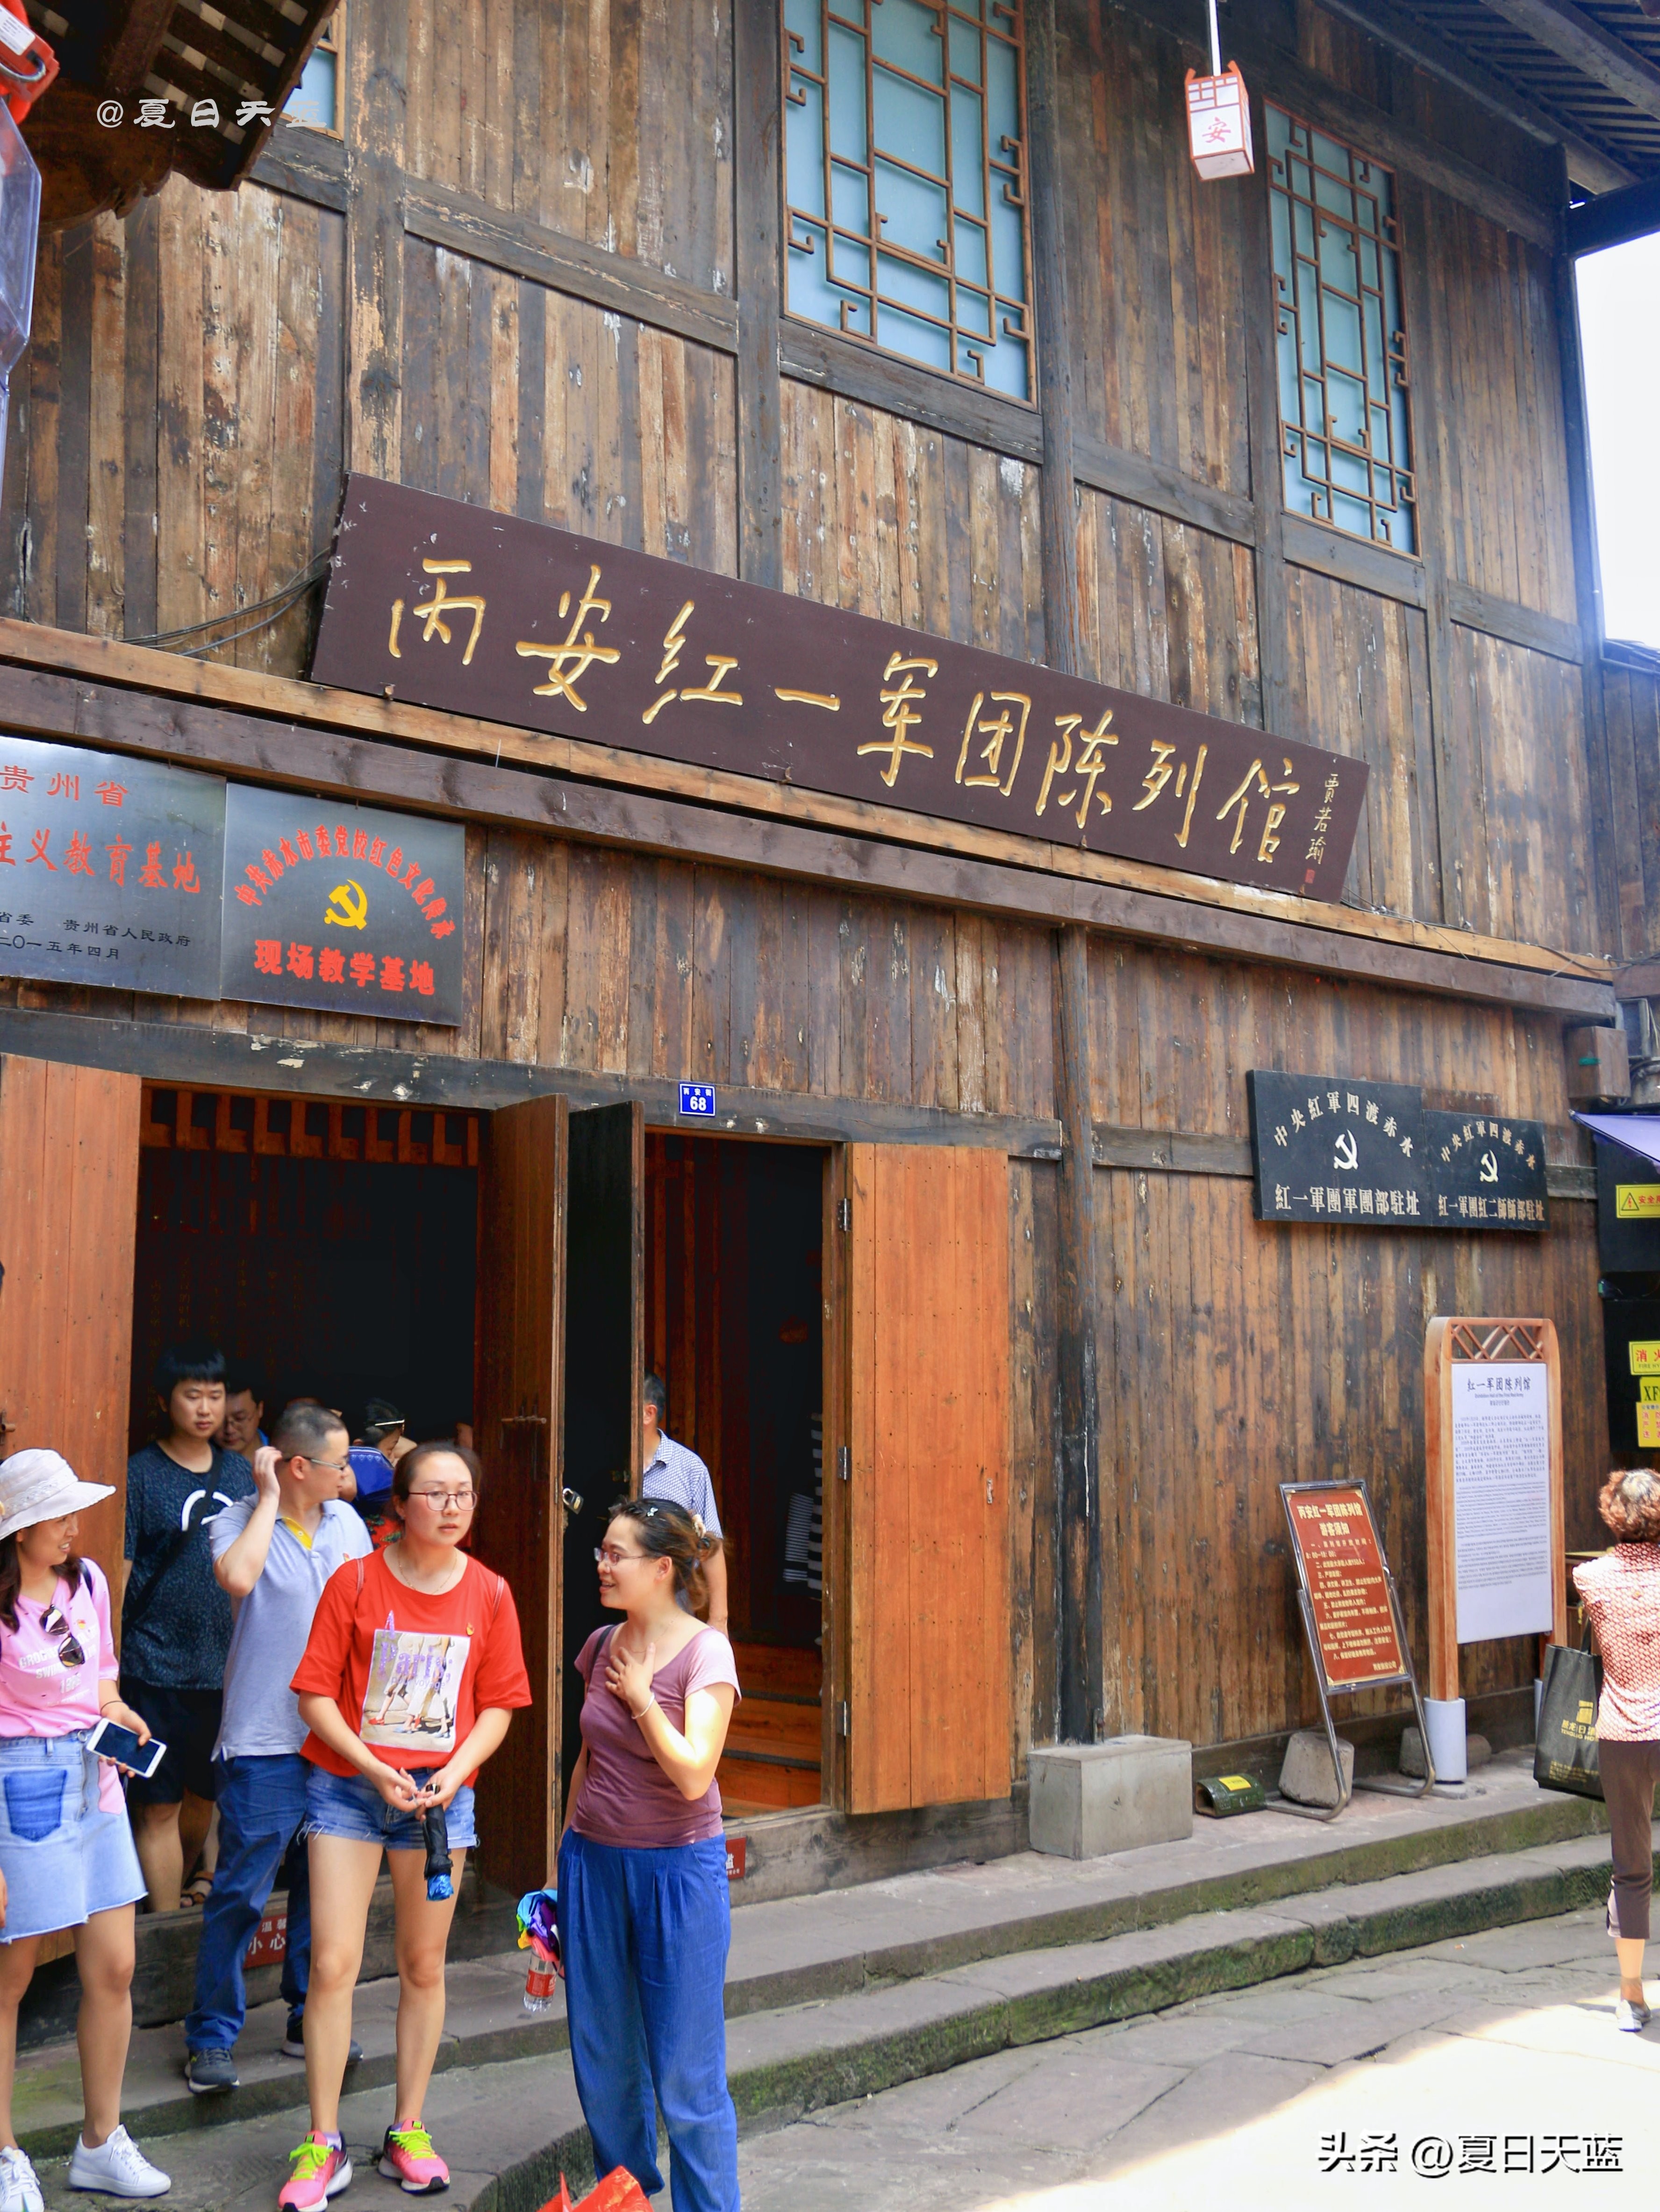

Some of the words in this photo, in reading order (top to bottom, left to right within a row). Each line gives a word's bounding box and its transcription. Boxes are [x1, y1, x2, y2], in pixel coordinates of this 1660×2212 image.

[1202, 117, 1231, 143] 安
[389, 559, 1300, 863] 丙安红一军团陈列馆
[0, 765, 129, 808] 贵州省
[63, 919, 191, 947] 贵州省人民政府
[254, 939, 435, 995] 现场教学基地
[690, 1096, 707, 1111] 68
[1467, 1376, 1531, 1392] 红一军团陈列馆
[1296, 1502, 1363, 1519] 丙安红一军团陈列馆
[248, 1932, 286, 1955] 小心
